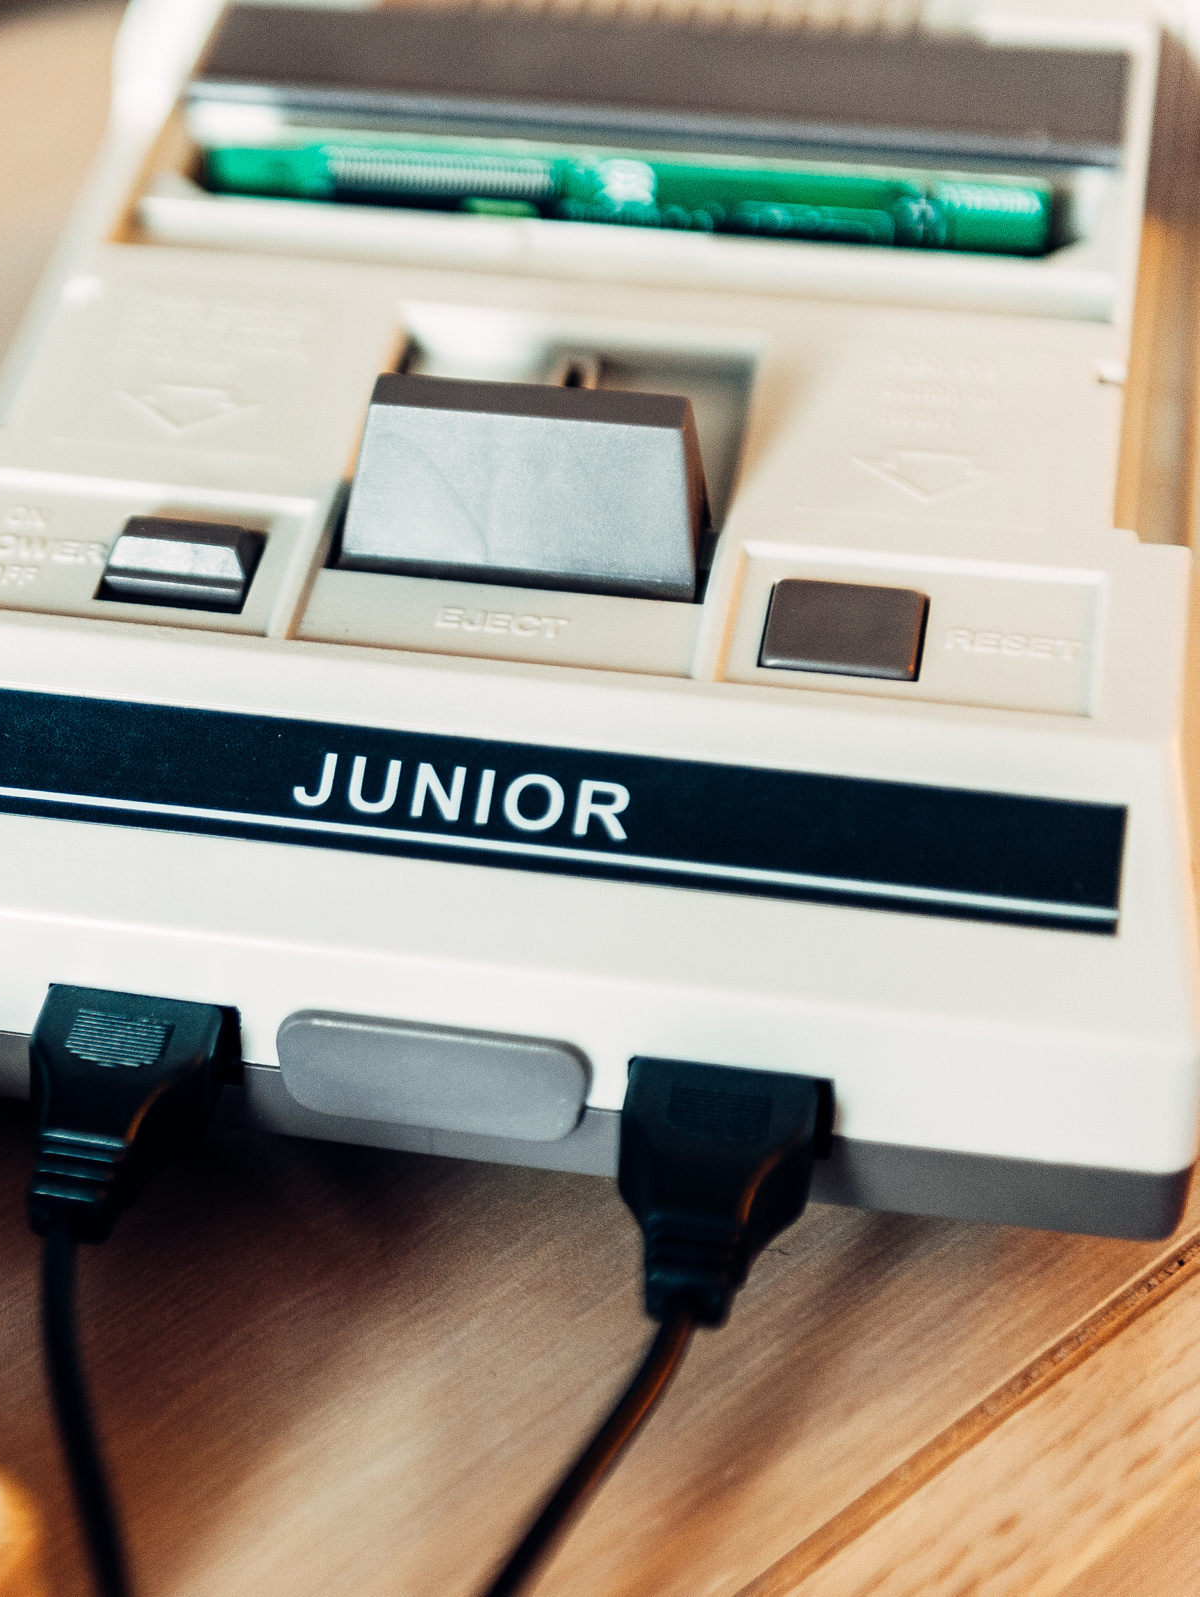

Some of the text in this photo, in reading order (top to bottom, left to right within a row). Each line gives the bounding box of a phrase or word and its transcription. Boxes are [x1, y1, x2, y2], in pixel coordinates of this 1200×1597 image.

[435, 605, 571, 639] EJECT
[943, 627, 1084, 662] RESET
[293, 752, 631, 841] JUNIOR
